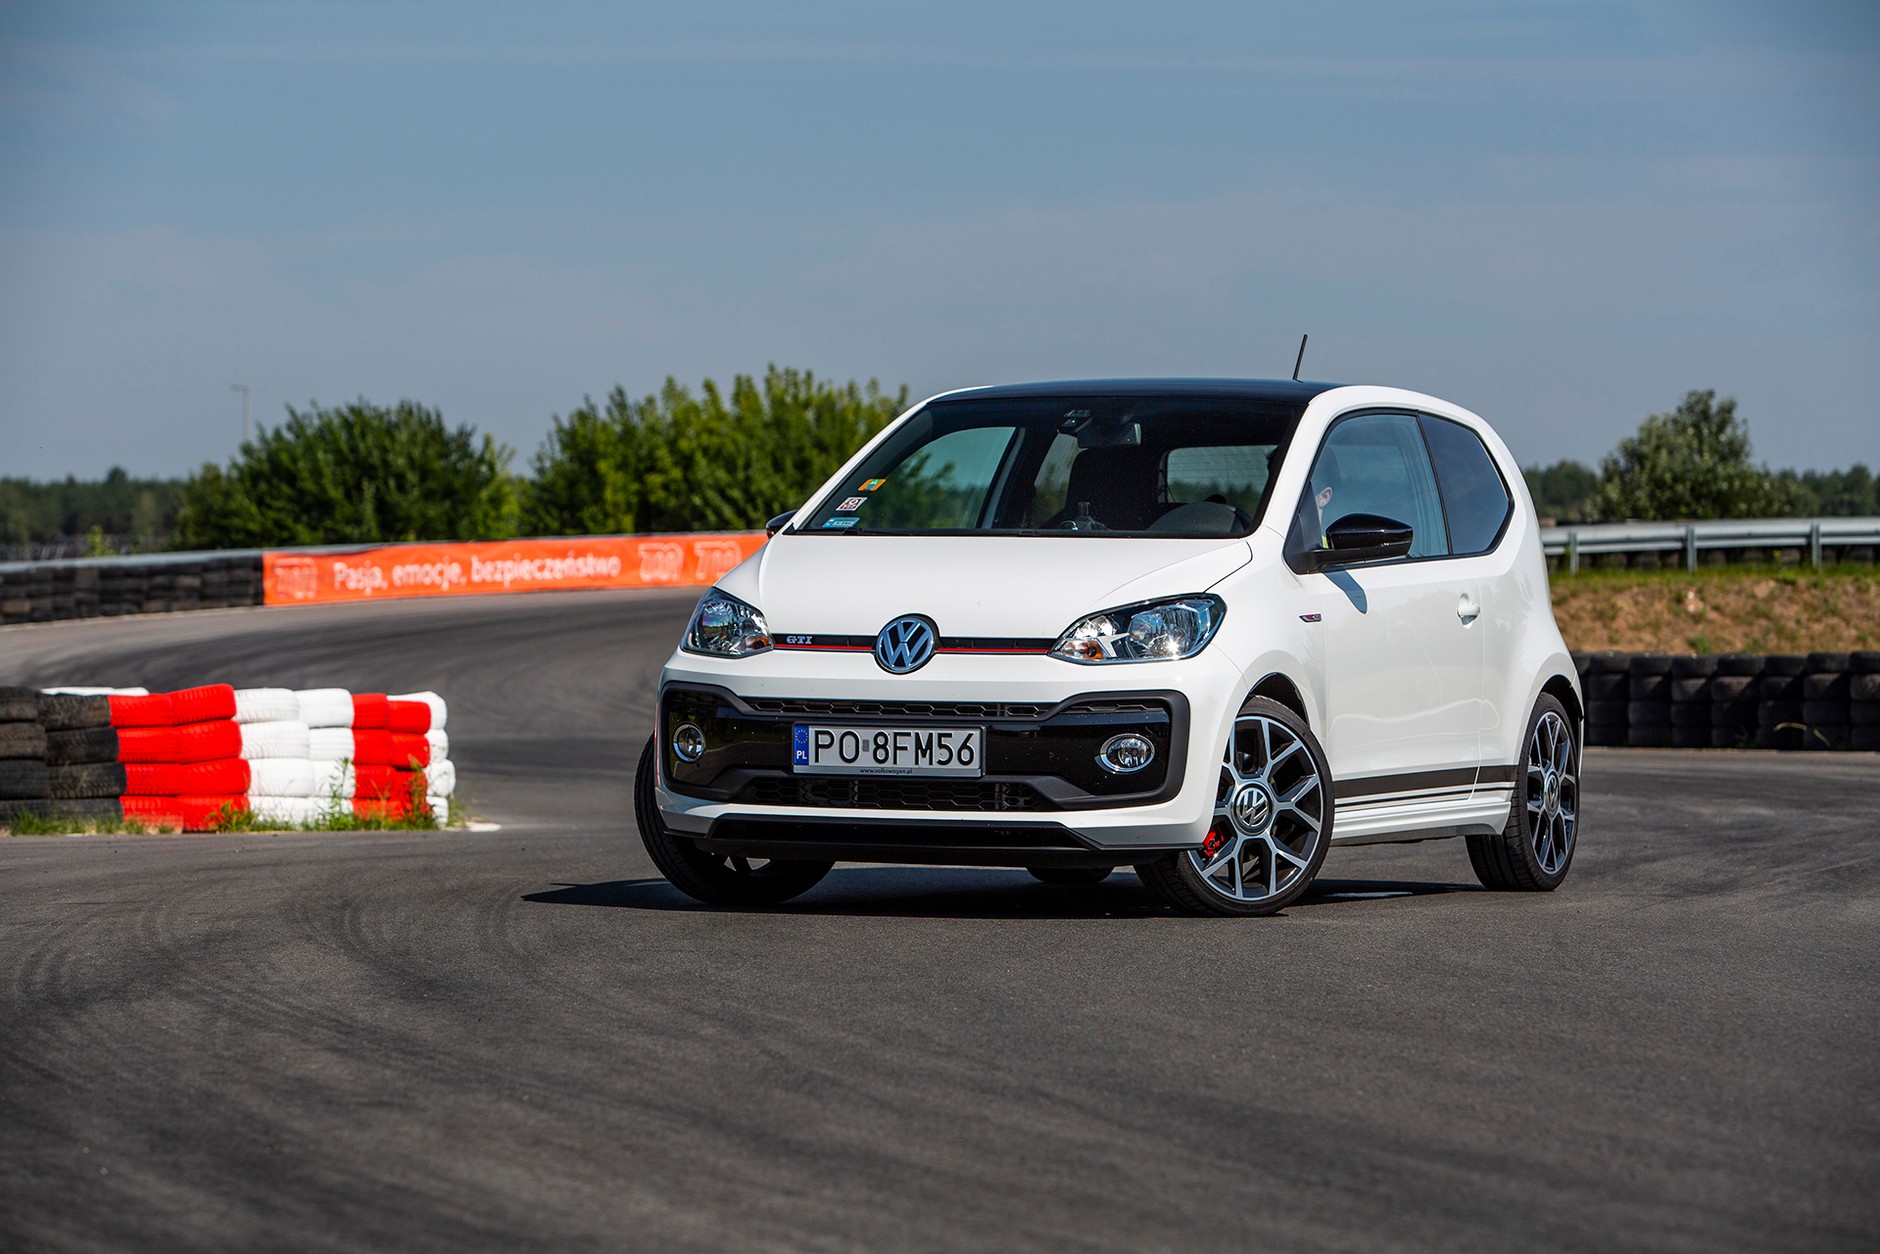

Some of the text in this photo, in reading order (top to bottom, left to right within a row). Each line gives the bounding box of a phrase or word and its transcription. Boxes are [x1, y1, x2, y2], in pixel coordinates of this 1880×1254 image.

[333, 560, 388, 596] Pasja,
[786, 636, 813, 644] GTI
[796, 750, 807, 760] PL
[814, 729, 975, 766] PO 8FM56
